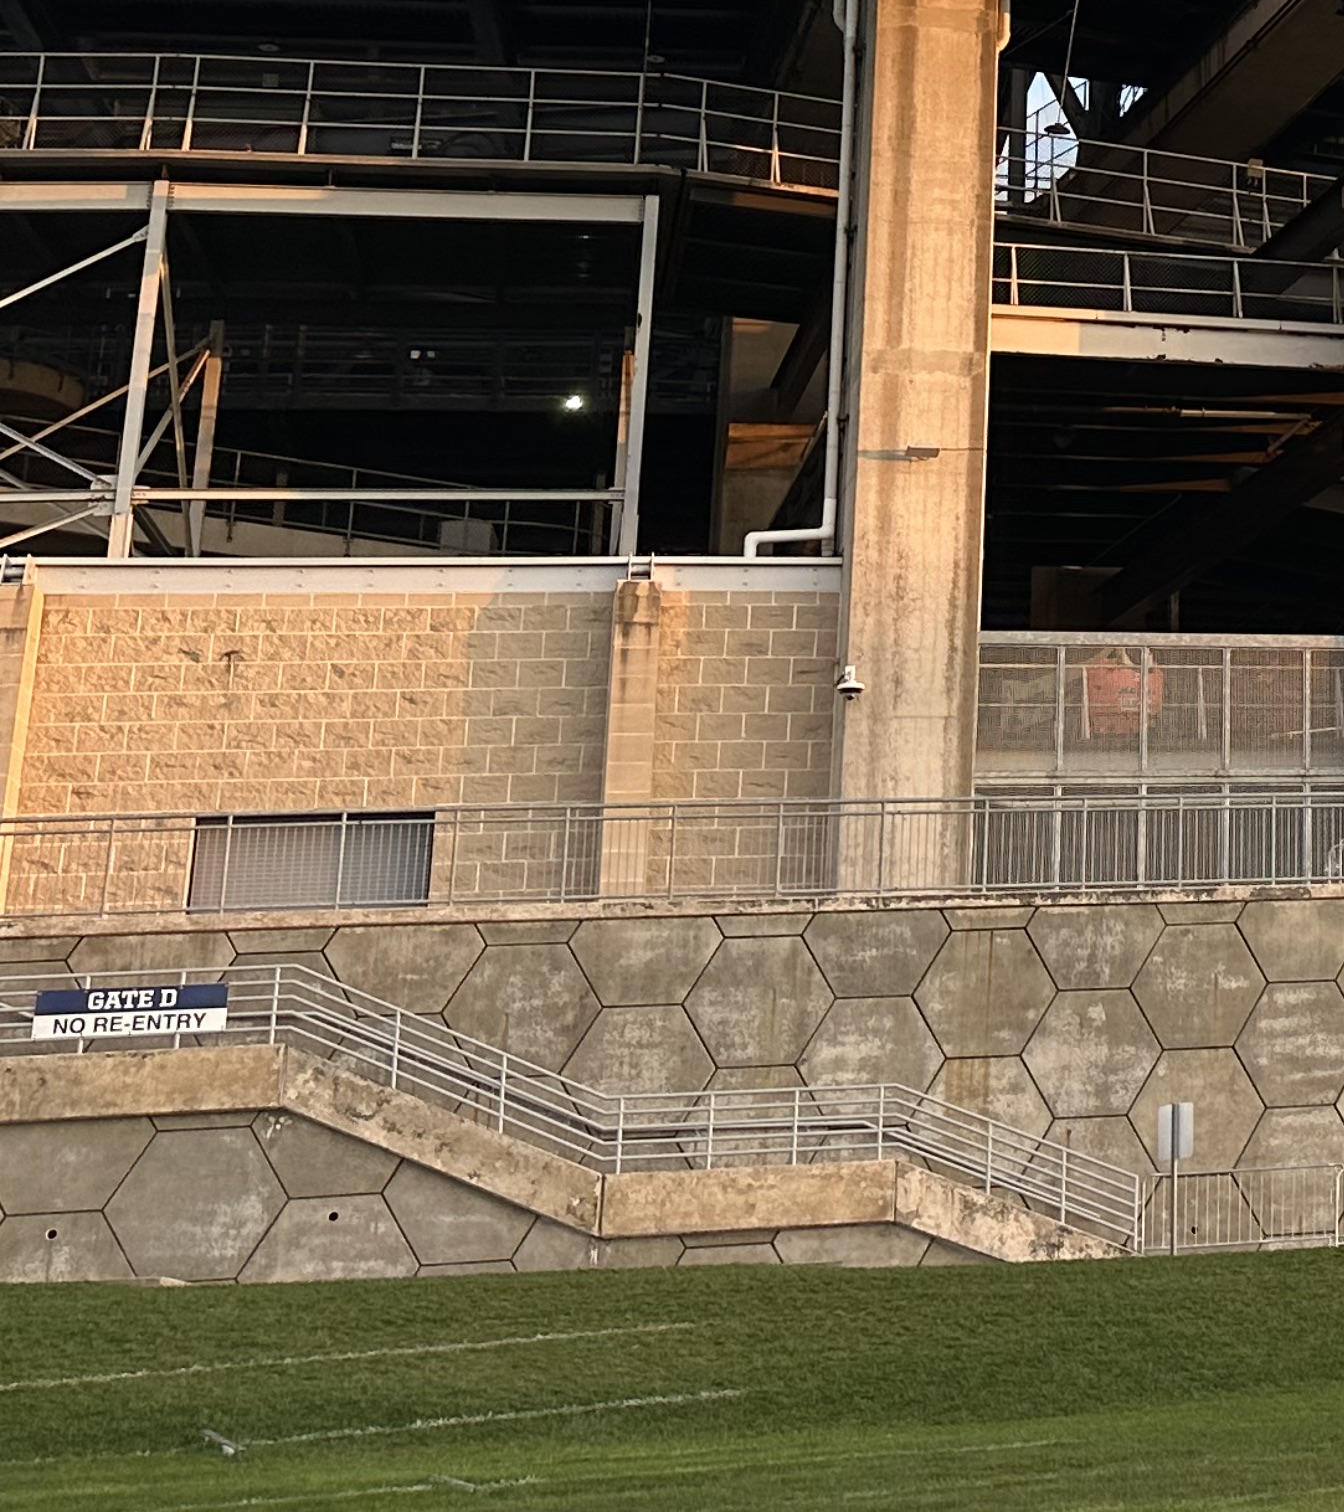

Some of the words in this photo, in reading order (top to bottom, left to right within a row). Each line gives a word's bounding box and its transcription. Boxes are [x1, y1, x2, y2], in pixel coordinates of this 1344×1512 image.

[87, 989, 154, 1010] GATE
[160, 989, 177, 1007] D
[53, 1017, 85, 1034] NO
[93, 1013, 207, 1033] RE-ENTRY
